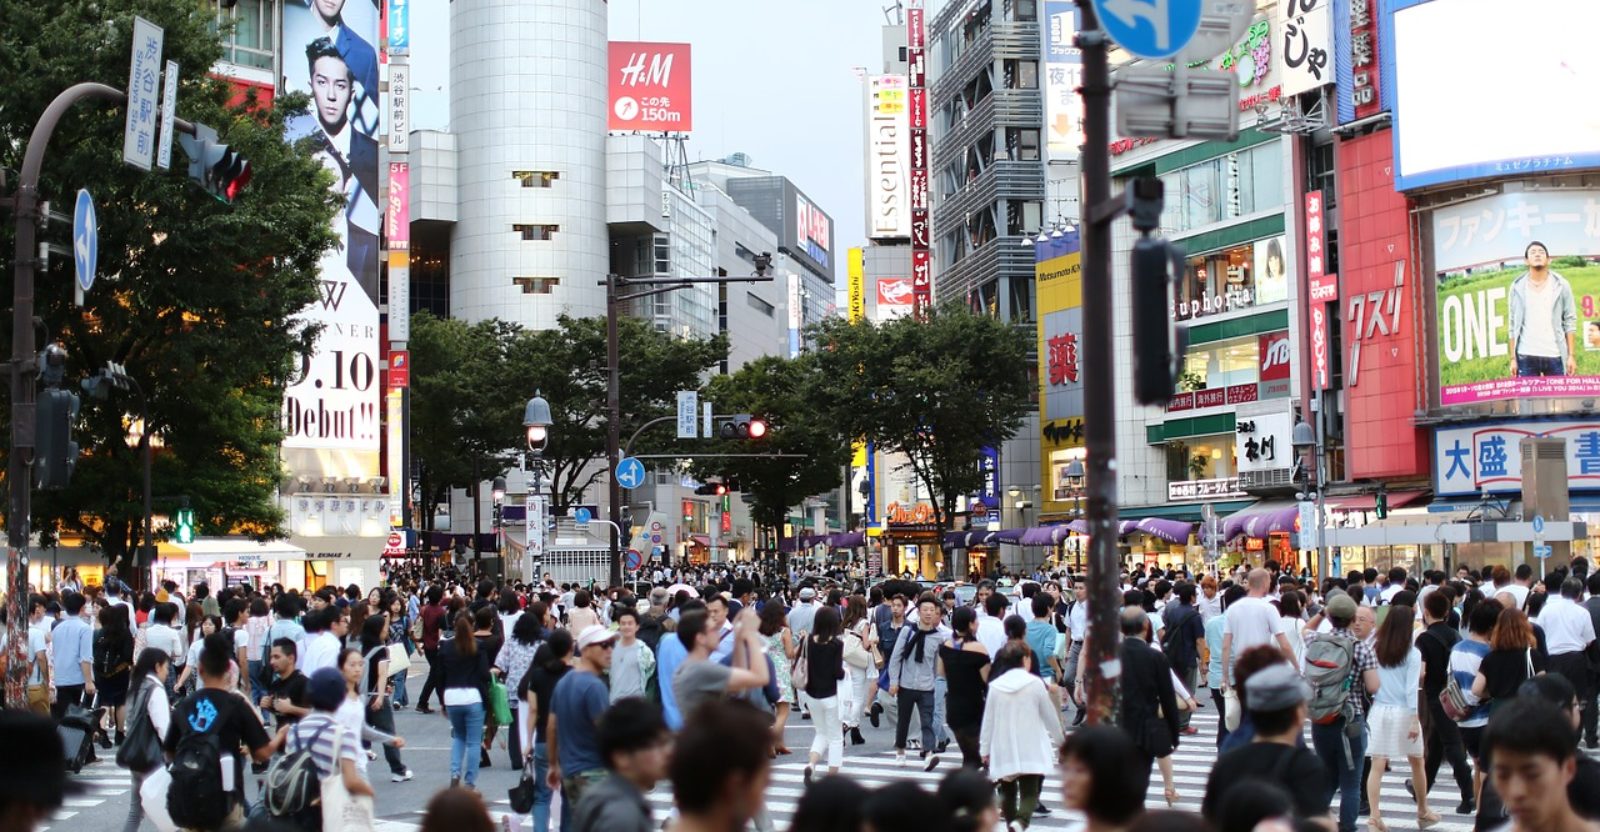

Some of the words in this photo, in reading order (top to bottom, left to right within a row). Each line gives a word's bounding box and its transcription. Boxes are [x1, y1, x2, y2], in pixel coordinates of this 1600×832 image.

[132, 50, 145, 104] Shibuya
[621, 52, 674, 88] H&M
[138, 36, 158, 156] 渋谷駅前
[393, 72, 405, 144] 渋谷駅前ビル
[641, 97, 671, 107] この先
[641, 108, 681, 122] 150m
[391, 163, 407, 174] 5F
[874, 117, 897, 232] Essential
[1495, 157, 1574, 171] ミュゼプラチナム
[1038, 267, 1070, 282] Matsumoto
[1349, 260, 1405, 386] クスリ
[1443, 287, 1509, 363] ONE
[1048, 333, 1078, 385] 薬
[1263, 338, 1289, 371] JTB
[285, 396, 374, 440] Debut!!
[1197, 392, 1223, 405] 海外旅行
[1445, 432, 1600, 480] 大盛書
[528, 501, 537, 551] 道玄坂
